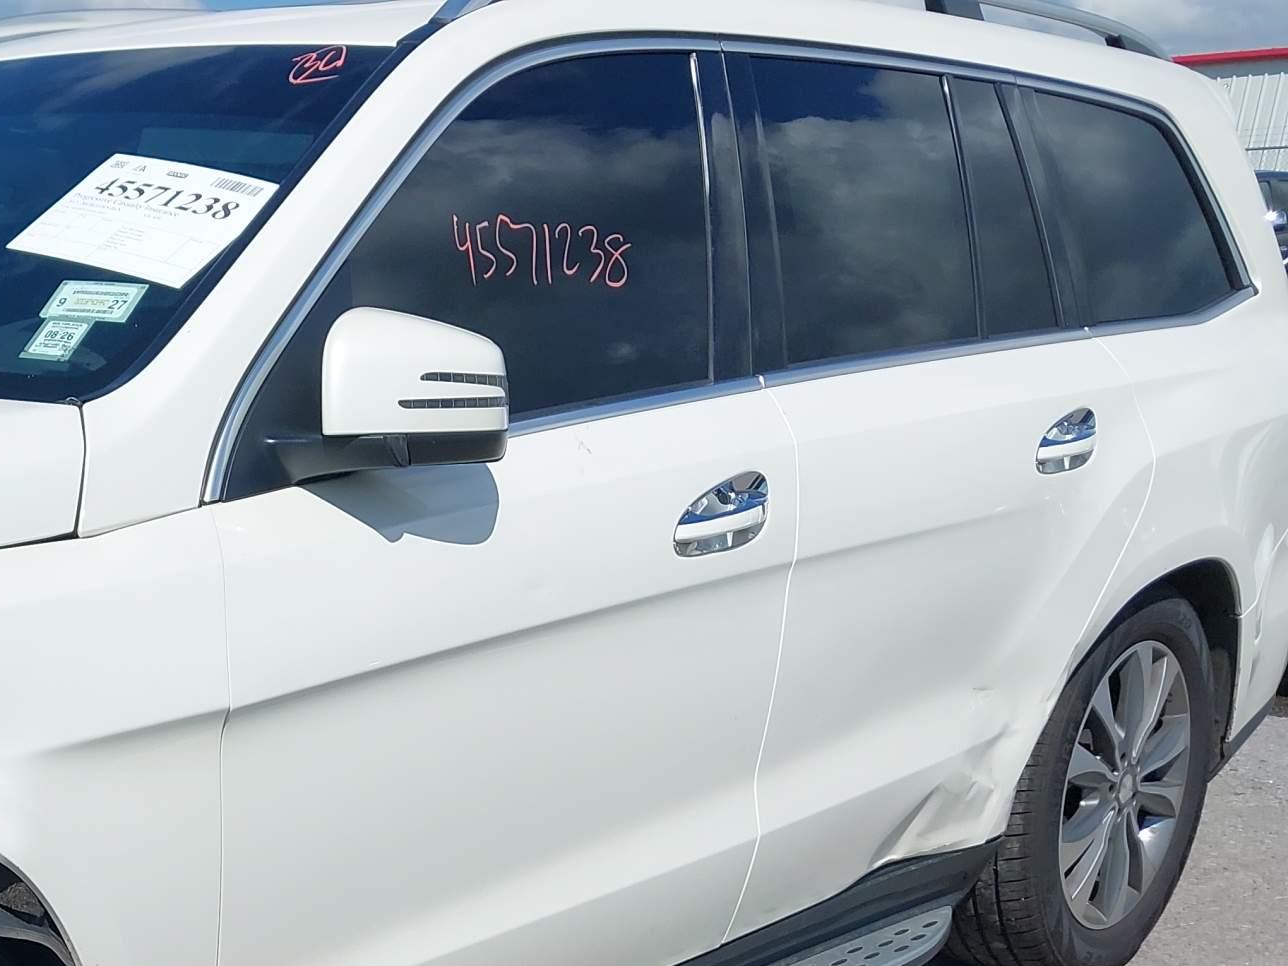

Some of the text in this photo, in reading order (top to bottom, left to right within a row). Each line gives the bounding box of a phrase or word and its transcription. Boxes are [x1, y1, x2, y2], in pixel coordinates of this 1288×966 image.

[94, 177, 241, 220] 45571238
[452, 213, 633, 288] 45571238
[56, 297, 67, 308] 9
[109, 298, 128, 310] 27
